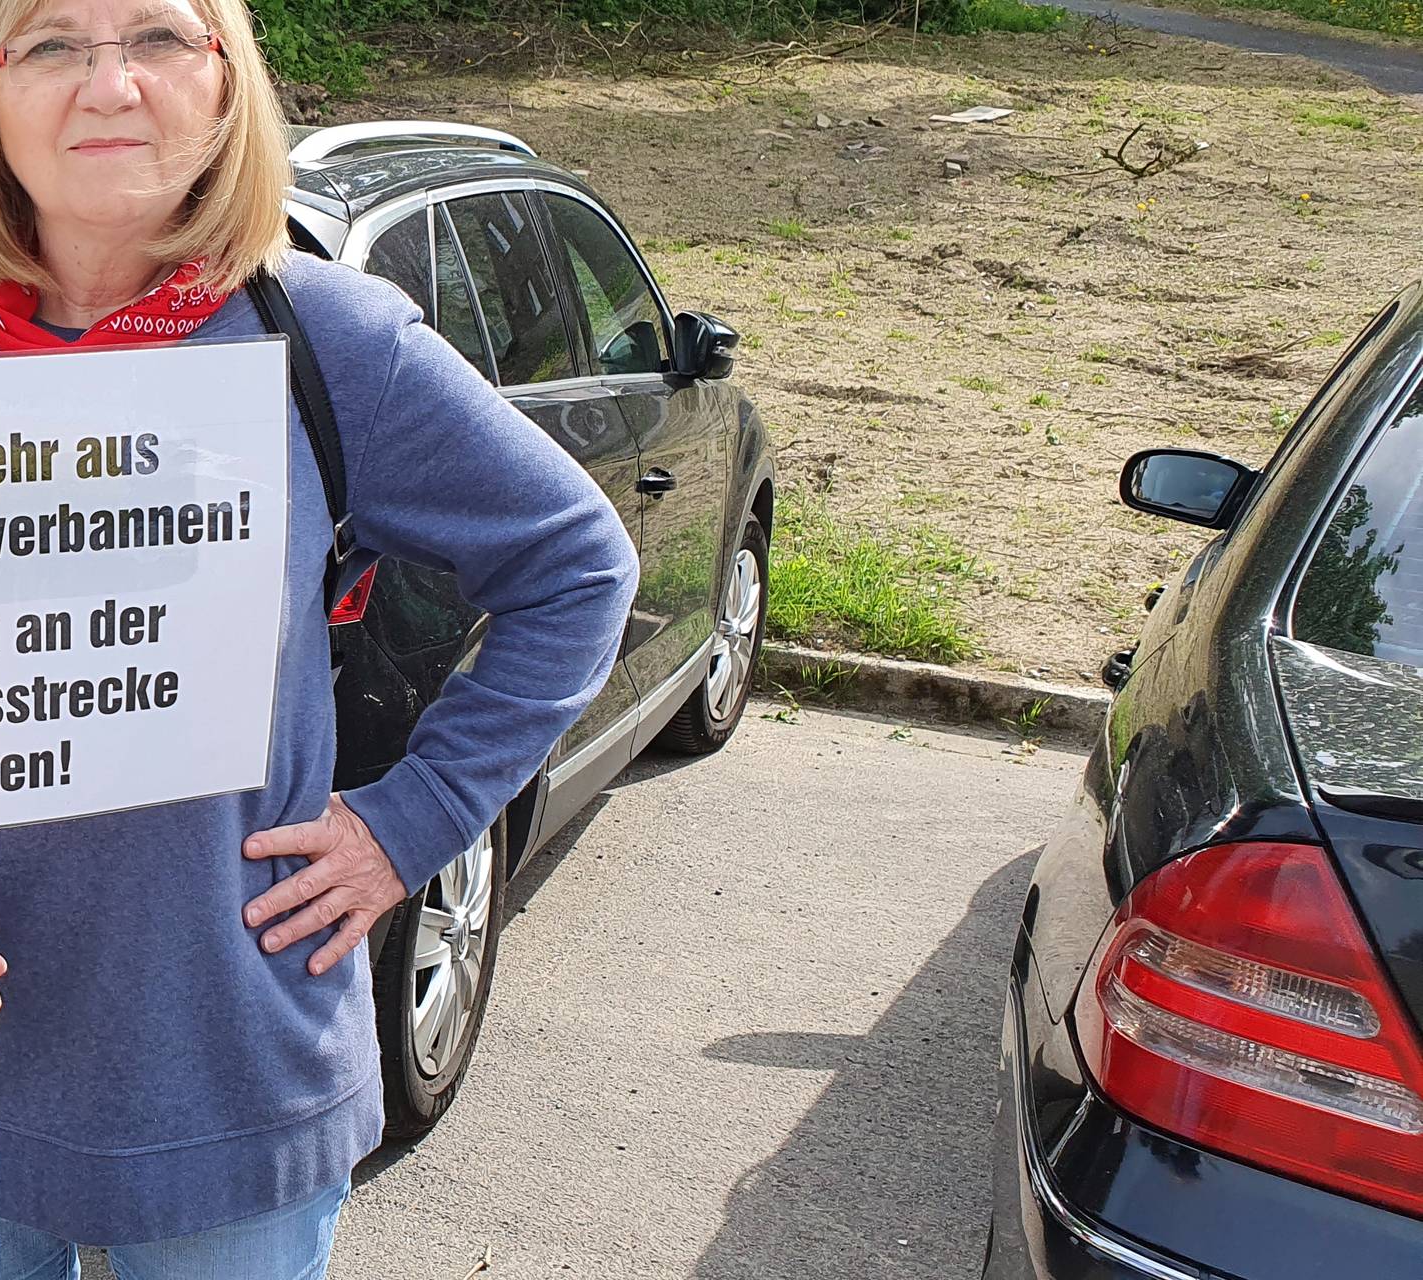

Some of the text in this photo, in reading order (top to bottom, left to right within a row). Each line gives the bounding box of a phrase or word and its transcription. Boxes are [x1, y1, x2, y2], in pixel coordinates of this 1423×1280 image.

[77, 434, 159, 478] aus
[16, 612, 71, 653] an
[90, 600, 166, 648] der
